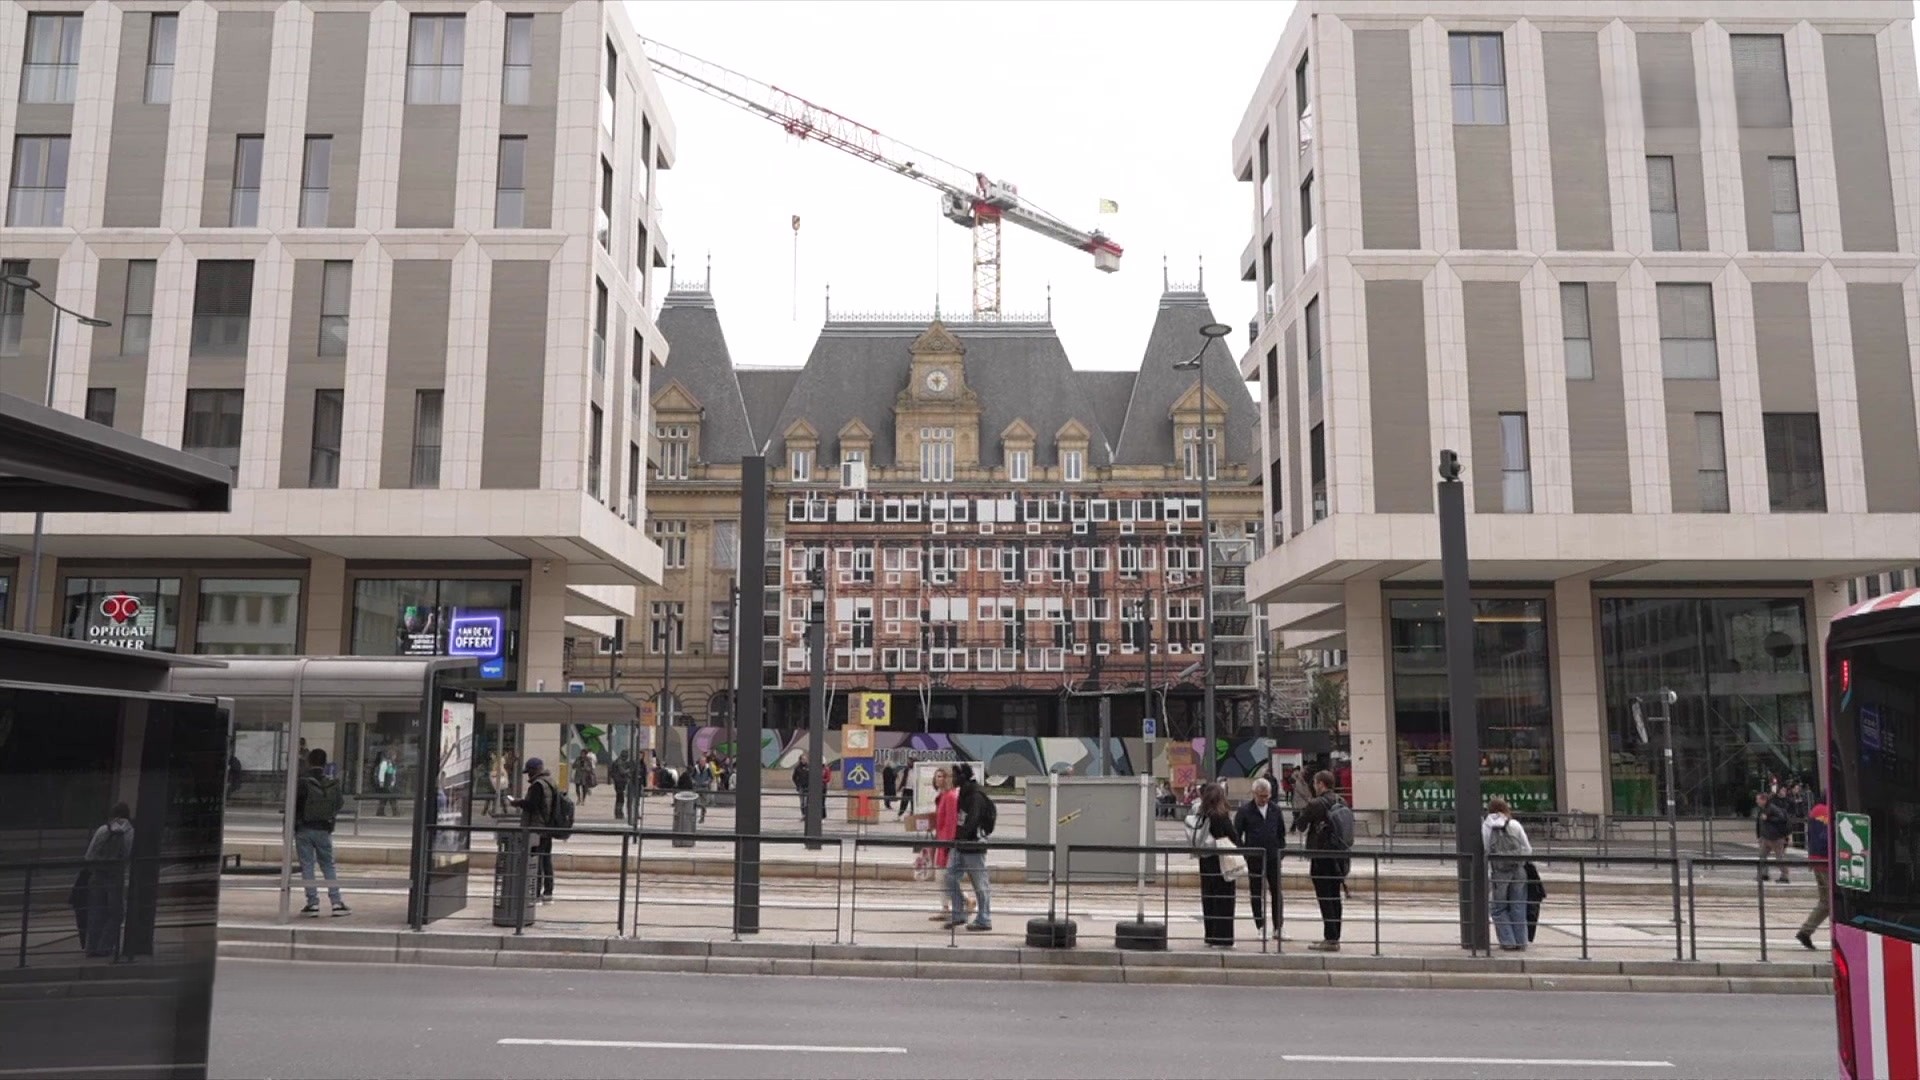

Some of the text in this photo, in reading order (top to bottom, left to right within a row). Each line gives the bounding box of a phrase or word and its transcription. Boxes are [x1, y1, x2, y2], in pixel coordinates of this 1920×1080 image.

[90, 625, 147, 637] OPTICAL
[455, 636, 494, 648] OFFERT
[1402, 788, 1456, 799] L'ATELI
[1482, 793, 1549, 801] BOULEVARD
[1403, 800, 1456, 810] STEFF
